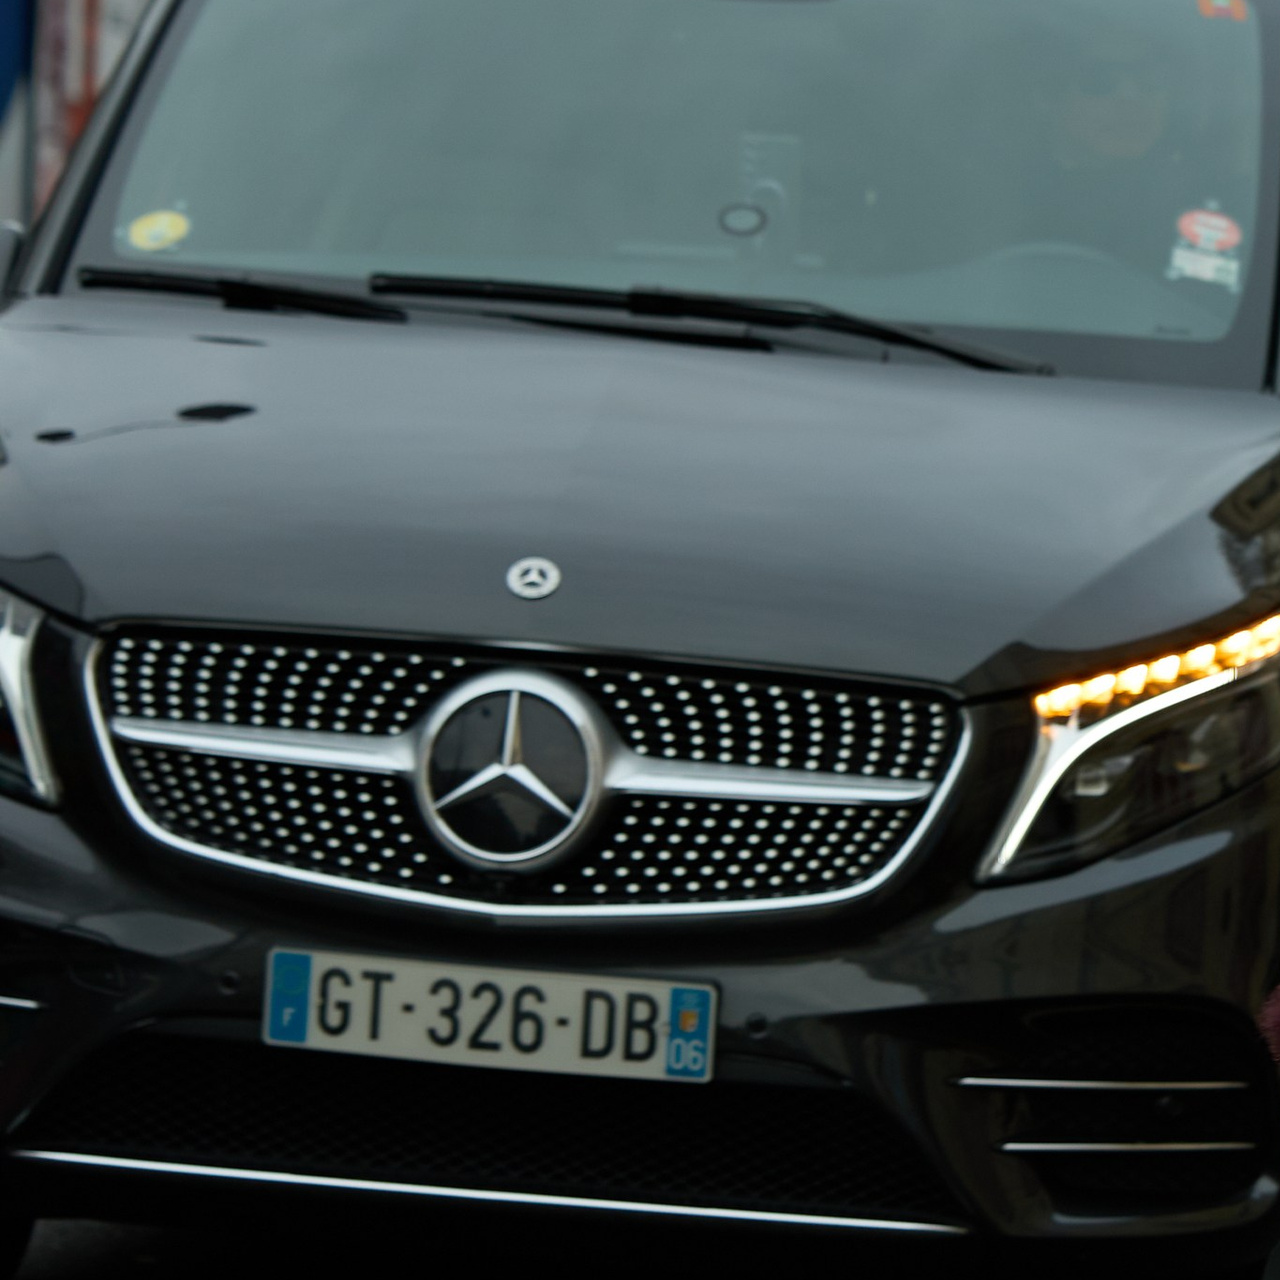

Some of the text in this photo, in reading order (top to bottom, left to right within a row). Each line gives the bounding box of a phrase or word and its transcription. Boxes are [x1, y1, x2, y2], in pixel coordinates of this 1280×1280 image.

[281, 1006, 296, 1028] F
[318, 967, 660, 1061] GT-326-DB
[669, 1037, 706, 1072] 06
